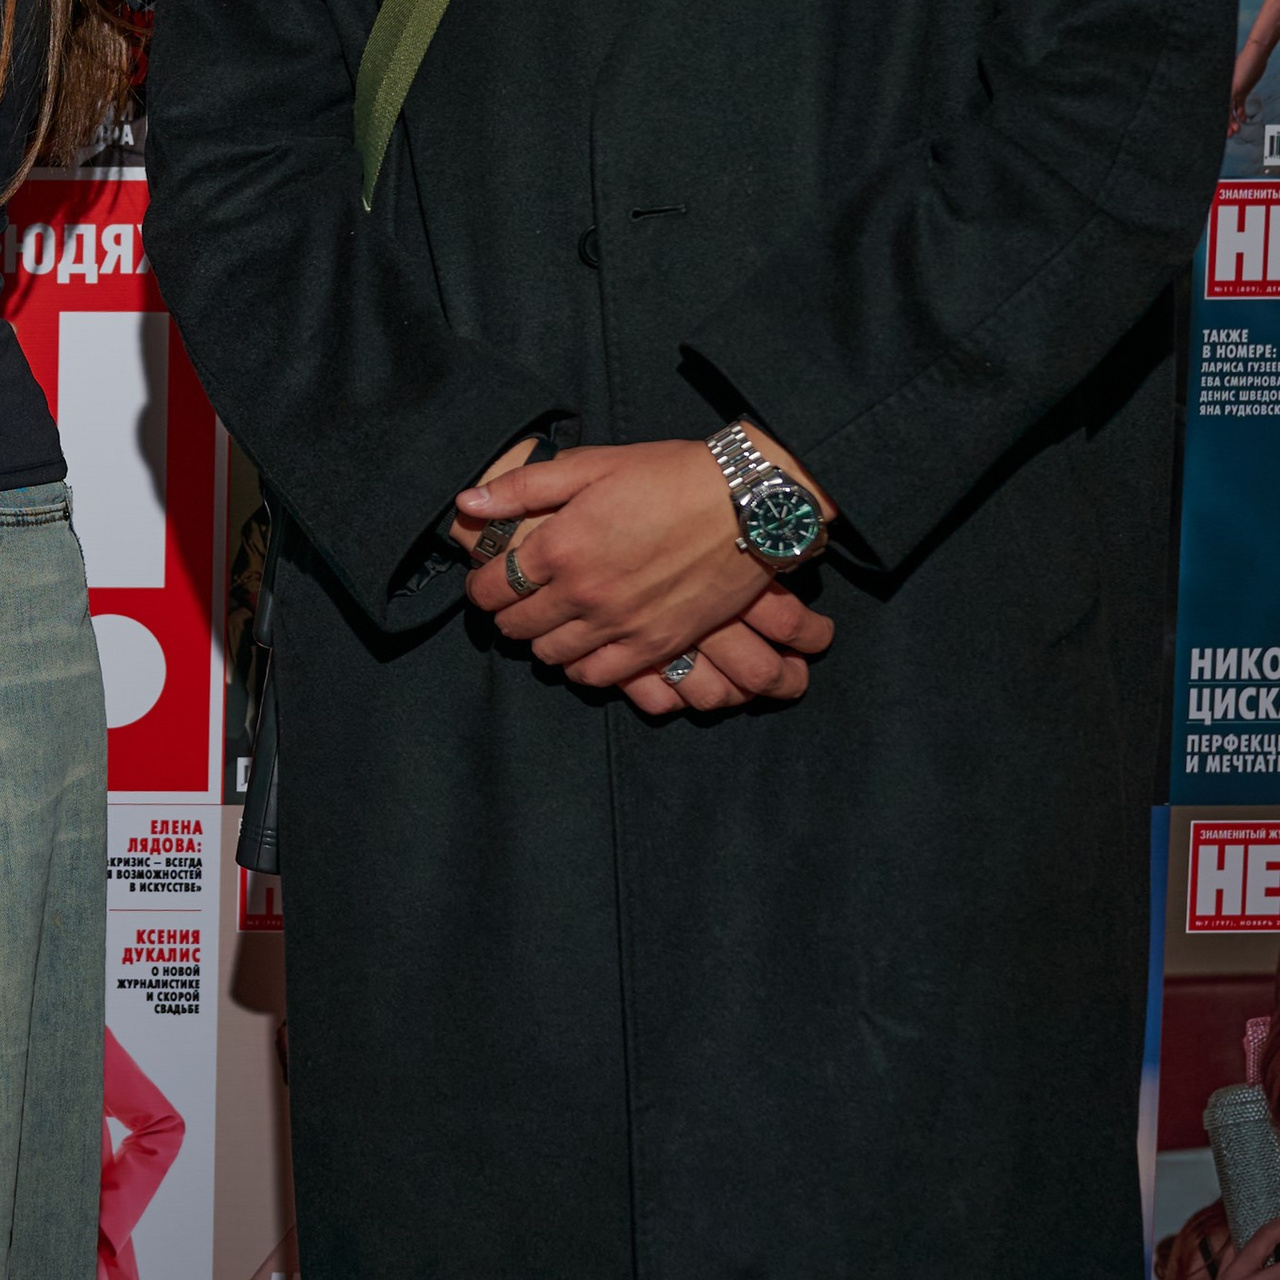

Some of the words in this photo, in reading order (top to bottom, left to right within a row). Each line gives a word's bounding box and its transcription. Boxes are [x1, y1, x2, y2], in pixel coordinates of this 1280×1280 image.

[1202, 329, 1249, 343] ТАКЖЕ
[1216, 345, 1276, 358] НОМЕРЕ:
[1201, 362, 1244, 372] ЛАРИСА
[1201, 376, 1220, 387] ЕВА
[1200, 390, 1235, 402] ДЕНИС
[1199, 405, 1221, 416] ЯНА
[1185, 755, 1199, 773] И
[150, 820, 203, 835] ЕЛЕНА
[1200, 828, 1266, 839] ЗНАМЕНИТЫЙ
[127, 838, 202, 855] ЛЯДОВА:
[165, 857, 202, 869] ВСЕГДА
[117, 867, 202, 880] ВОЗМОЖНОСТЕЙ
[139, 882, 202, 892] ИСКУССТВЕ»
[136, 929, 200, 945] КСЕНИЯ
[122, 947, 200, 965] ДУКАЛИС
[163, 964, 200, 976] НОВОЙ
[117, 979, 200, 989] ЖУРНАЛИСТИКЕ
[157, 990, 199, 1001] СКОРОЙ
[154, 1004, 199, 1015] СВАДЬБЕ
